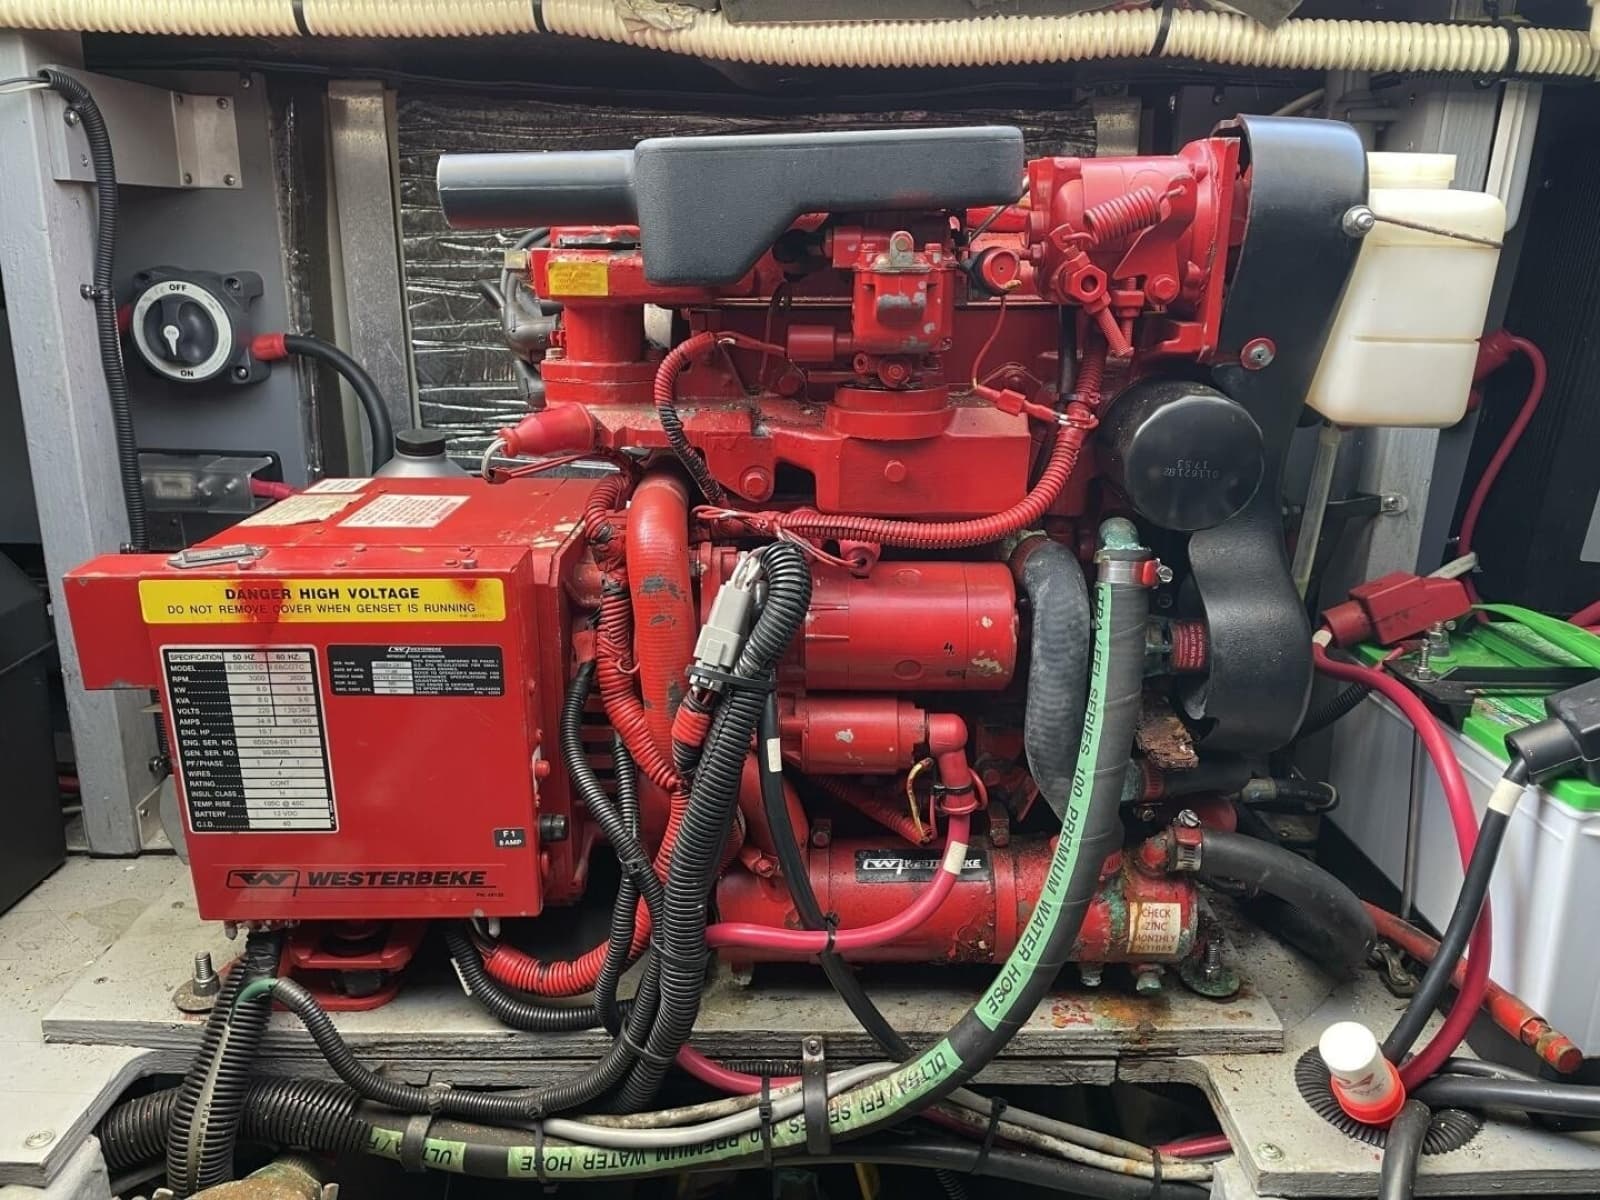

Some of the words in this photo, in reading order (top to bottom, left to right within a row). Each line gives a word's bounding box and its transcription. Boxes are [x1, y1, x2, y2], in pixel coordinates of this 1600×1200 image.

[181, 369, 194, 377] ON
[225, 588, 291, 600] DANGER
[300, 588, 339, 599] HIGH
[348, 588, 420, 599] VOLTAGE
[168, 605, 184, 614] DO
[190, 605, 212, 614] NOT
[219, 604, 268, 614] REMOVE
[273, 604, 312, 613] COVER
[317, 604, 350, 613] WHEN
[356, 604, 402, 613] GENSET
[408, 604, 418, 613] IS
[424, 603, 475, 612] RUNNING
[1080, 688, 1098, 756] SERIES
[1072, 767, 1086, 798] 100
[1047, 807, 1079, 896] PREMIUM
[308, 870, 487, 886] WESTERBEKE
[1142, 908, 1171, 919] CHECK
[1018, 899, 1051, 962] WATER
[1144, 921, 1168, 931] ZINC
[1136, 934, 1177, 943] MONTHLY
[986, 963, 1021, 1015] HOSE
[520, 1156, 572, 1172] HOE
[583, 1152, 646, 1170] WATER
